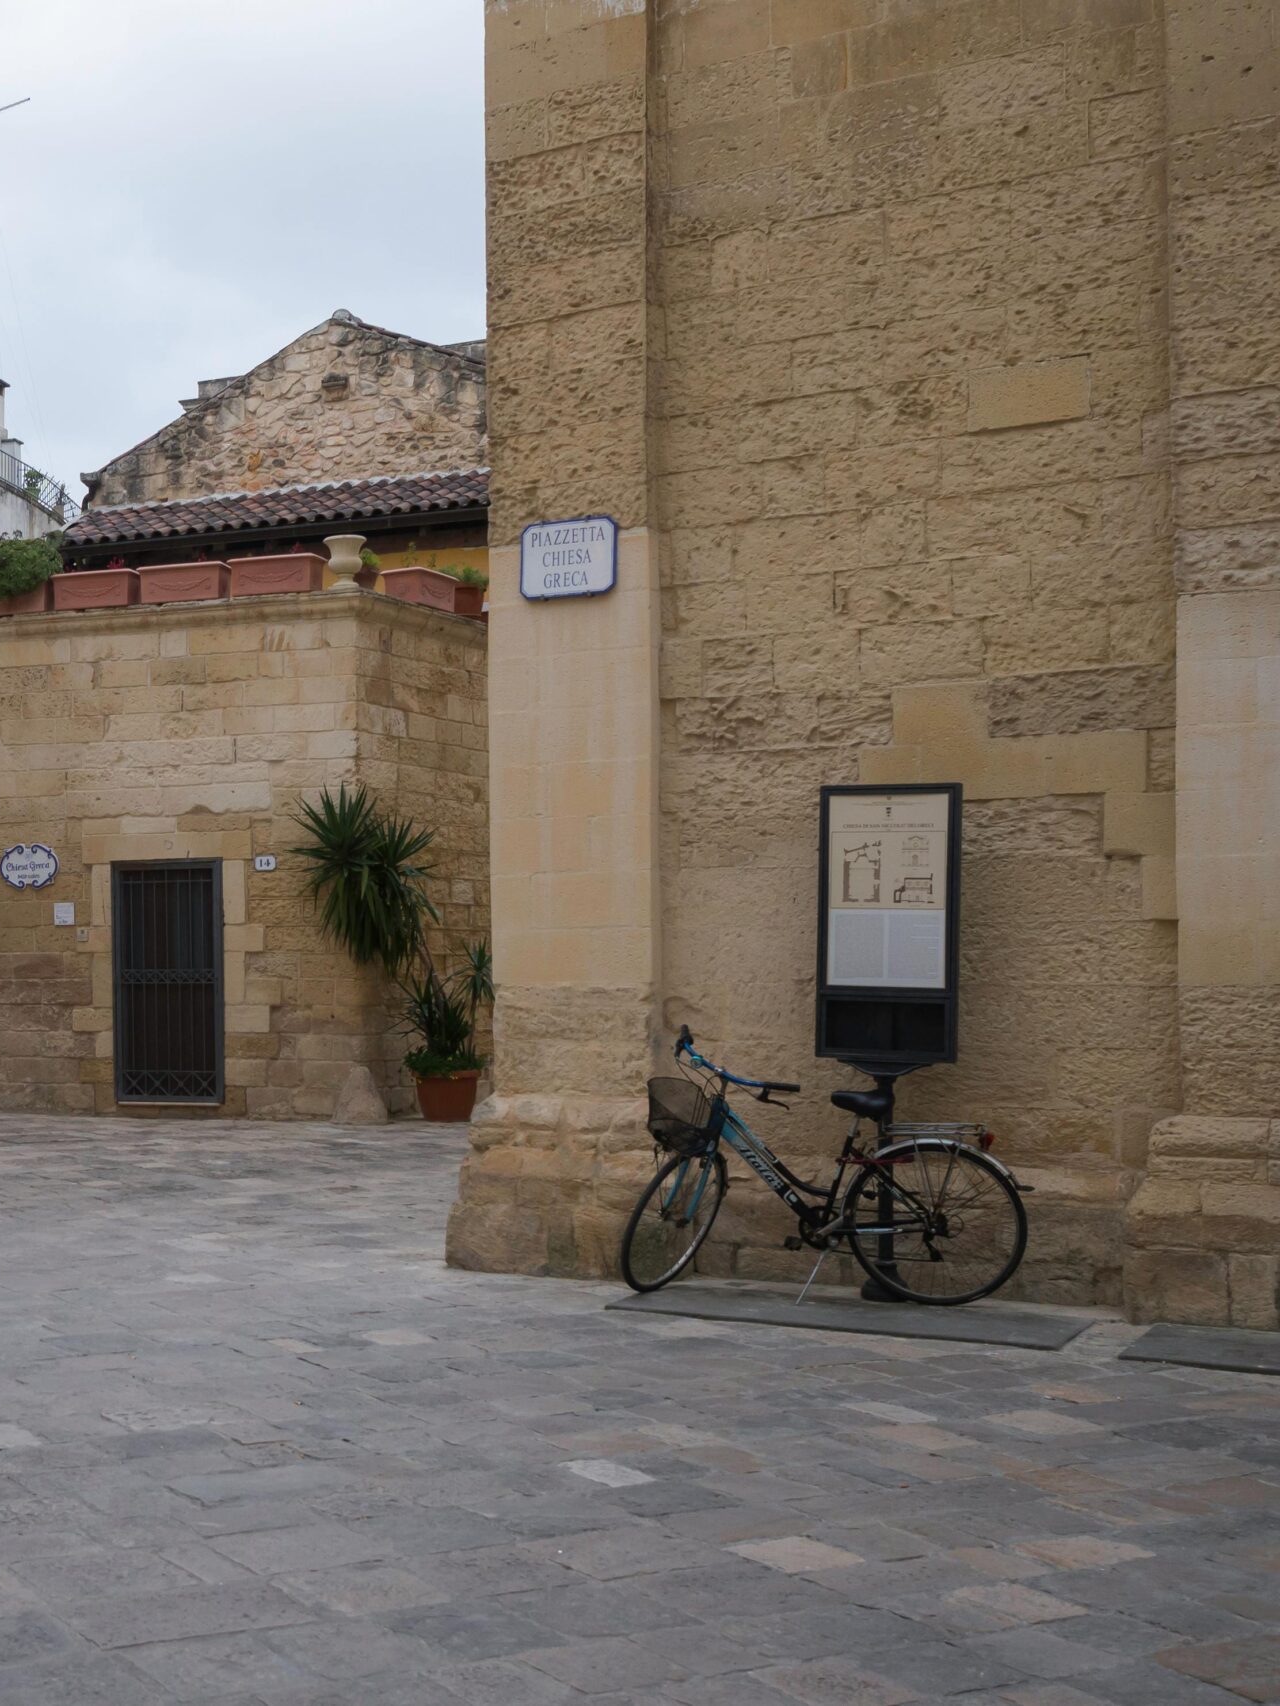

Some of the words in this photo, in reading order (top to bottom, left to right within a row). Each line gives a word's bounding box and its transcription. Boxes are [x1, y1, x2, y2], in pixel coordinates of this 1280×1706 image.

[531, 526, 605, 547] PIAZZETTA
[543, 548, 591, 567] CHIESA
[543, 571, 588, 589] GRECA
[259, 859, 271, 867] 14
